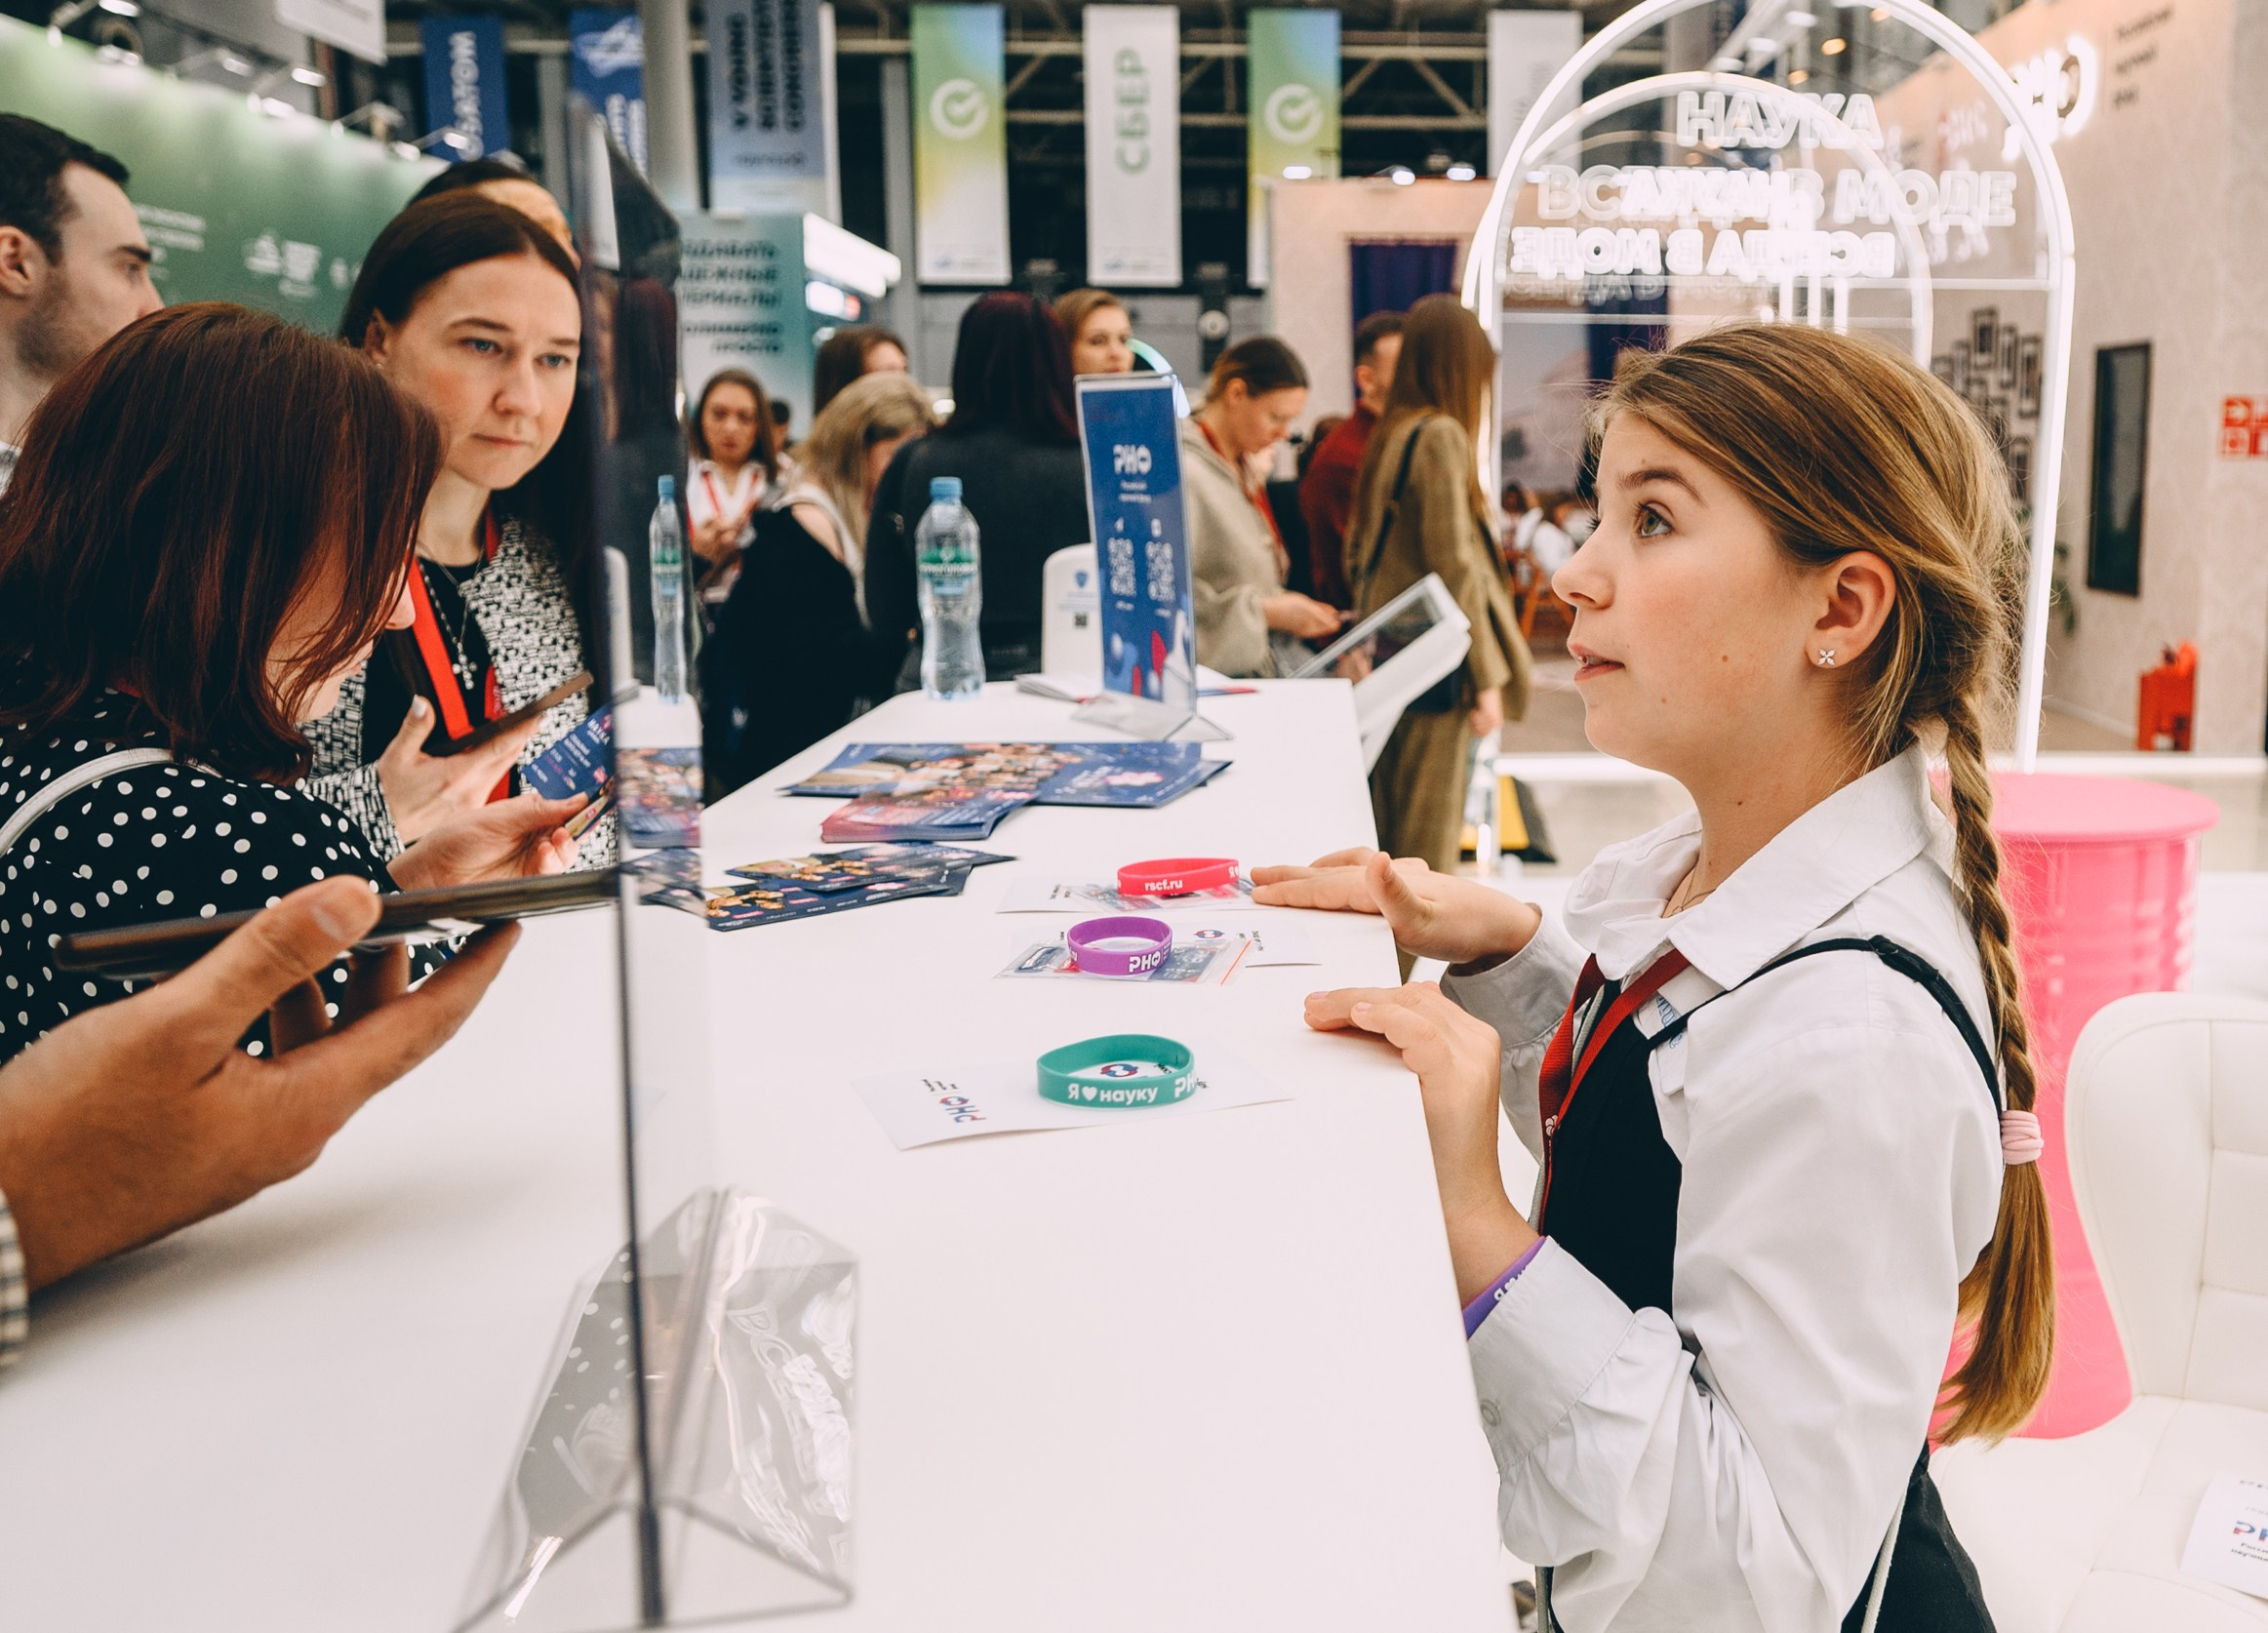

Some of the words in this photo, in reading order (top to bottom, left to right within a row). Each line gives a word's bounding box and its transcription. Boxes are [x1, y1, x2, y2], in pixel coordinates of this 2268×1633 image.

[1115, 47, 1151, 175] СБЕР
[1676, 91, 1885, 149] НАУКА
[1834, 169, 2016, 234] МОДЕ
[1144, 879, 1183, 892] rscf.ru
[1067, 1083, 1080, 1100] Я
[1099, 1087, 1159, 1105] науку
